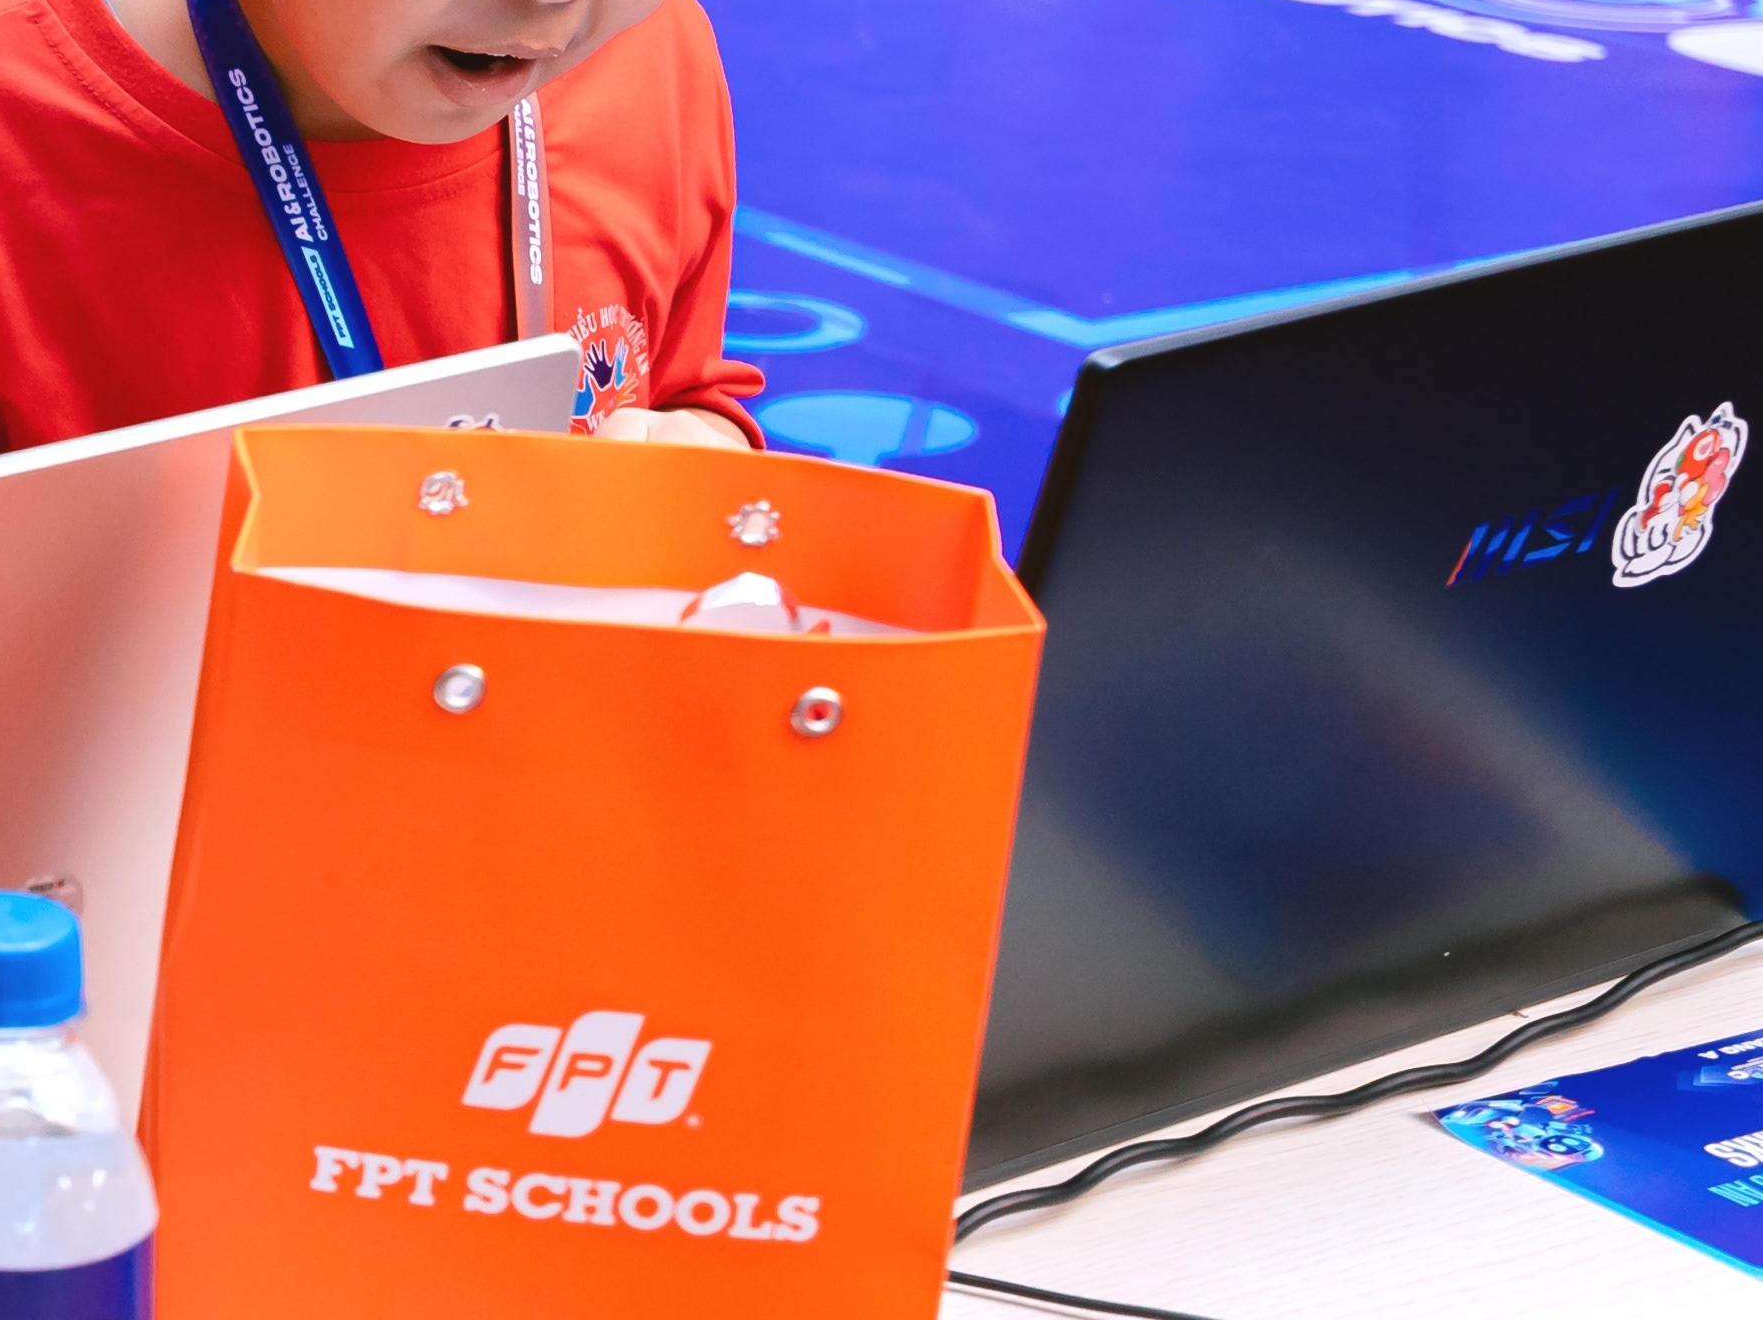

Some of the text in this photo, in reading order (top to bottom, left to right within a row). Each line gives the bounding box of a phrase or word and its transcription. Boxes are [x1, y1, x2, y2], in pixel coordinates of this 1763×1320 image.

[283, 144, 329, 241] CHALLENGE
[310, 254, 336, 312] SCHOOLS
[1446, 487, 1622, 587] MSI
[463, 1012, 711, 1137] FPT
[310, 1145, 822, 1243] FPT SCHOOLS
